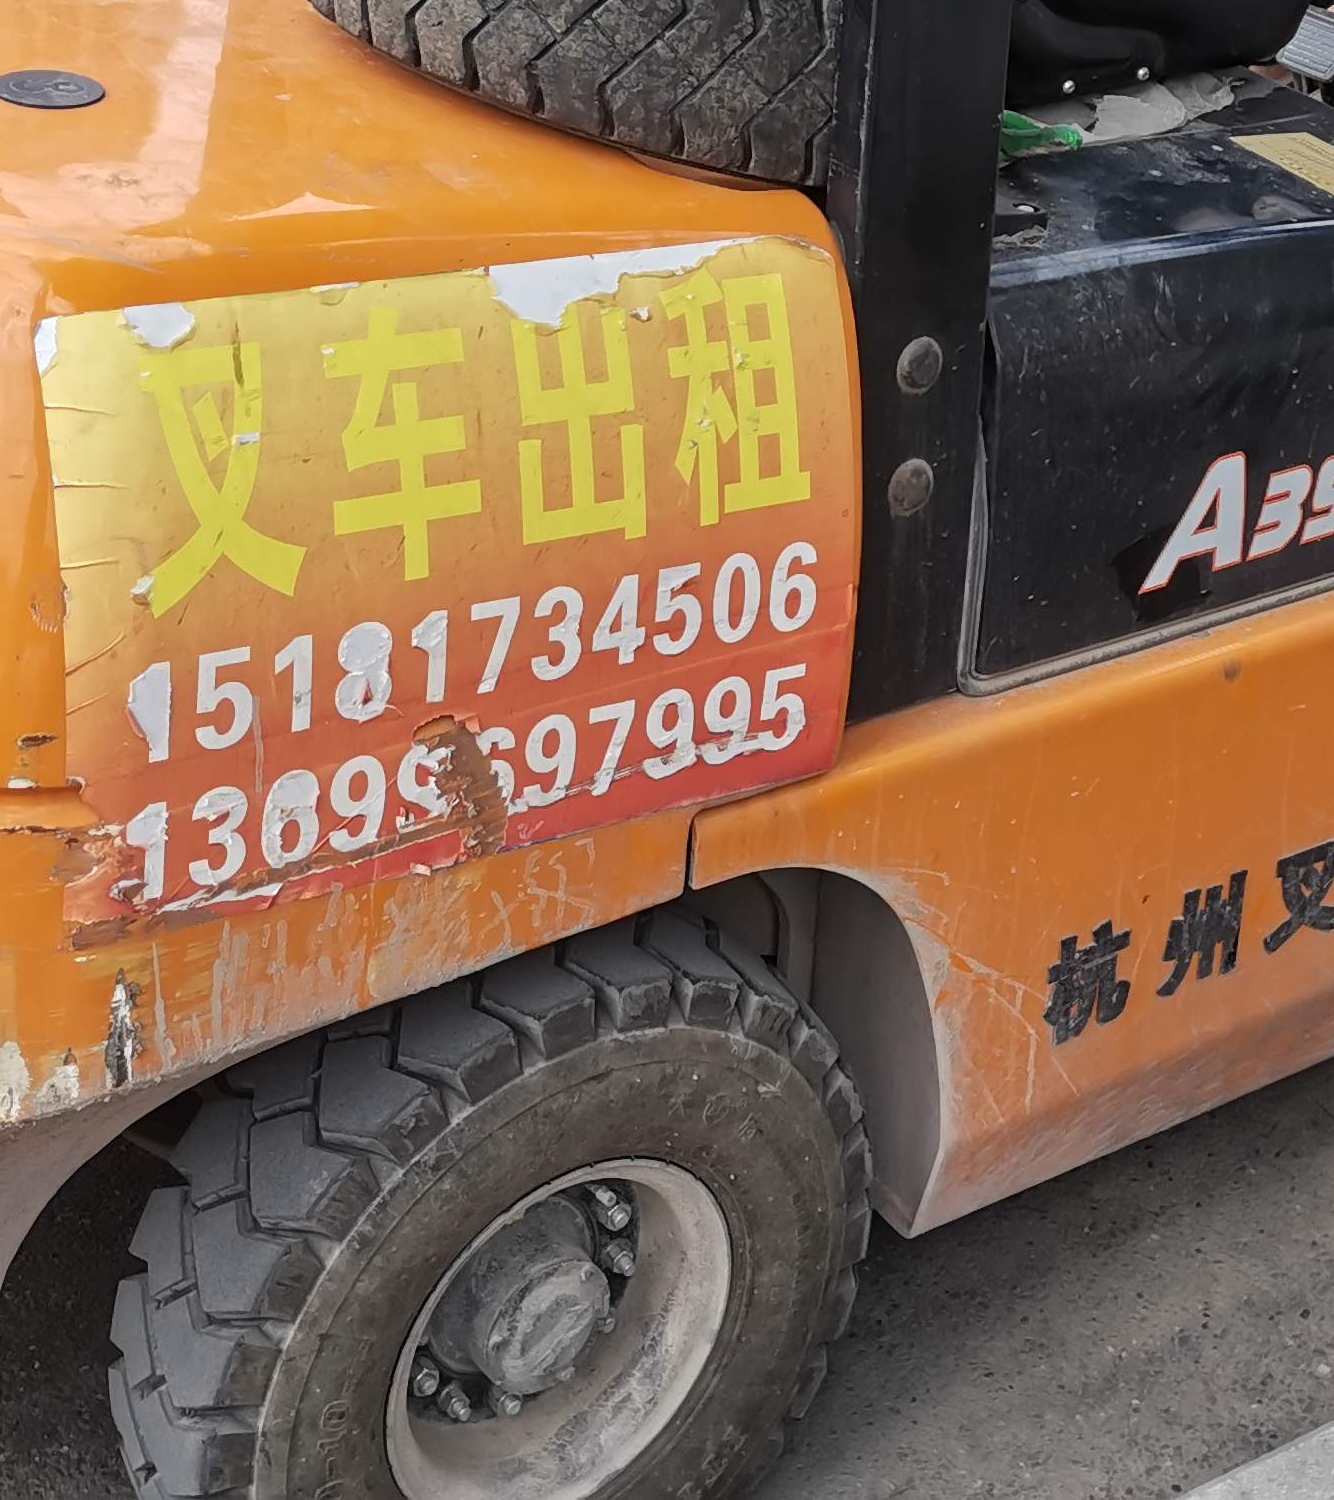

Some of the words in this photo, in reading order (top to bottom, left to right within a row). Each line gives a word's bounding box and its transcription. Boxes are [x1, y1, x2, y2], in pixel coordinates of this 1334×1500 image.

[133, 268, 813, 619] 叉车出租
[125, 540, 820, 764] 15181734506
